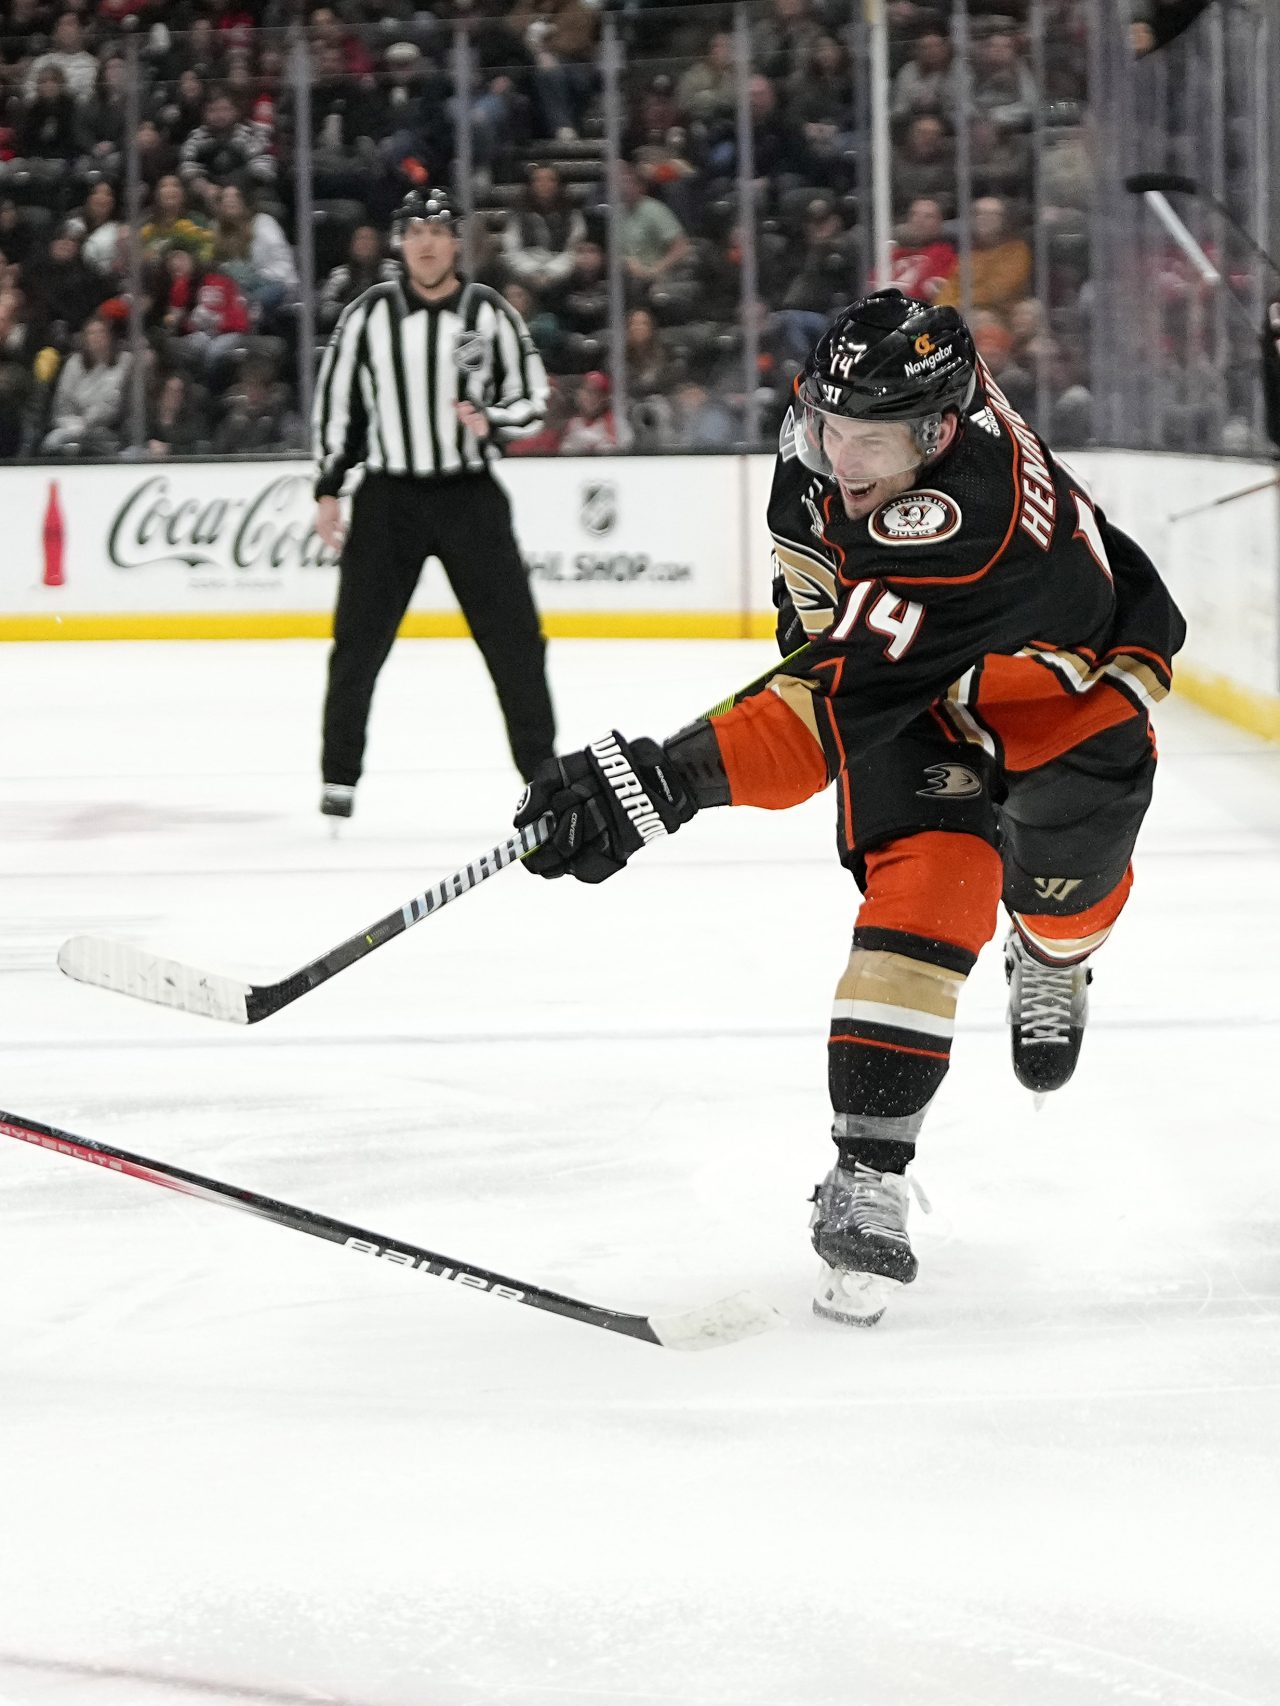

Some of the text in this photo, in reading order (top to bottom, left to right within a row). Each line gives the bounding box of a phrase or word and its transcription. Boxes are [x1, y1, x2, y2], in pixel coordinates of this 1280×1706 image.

[830, 354, 853, 380] 14
[904, 344, 953, 379] Navigator
[977, 354, 1056, 550] HENRIQU
[828, 580, 926, 662] 14
